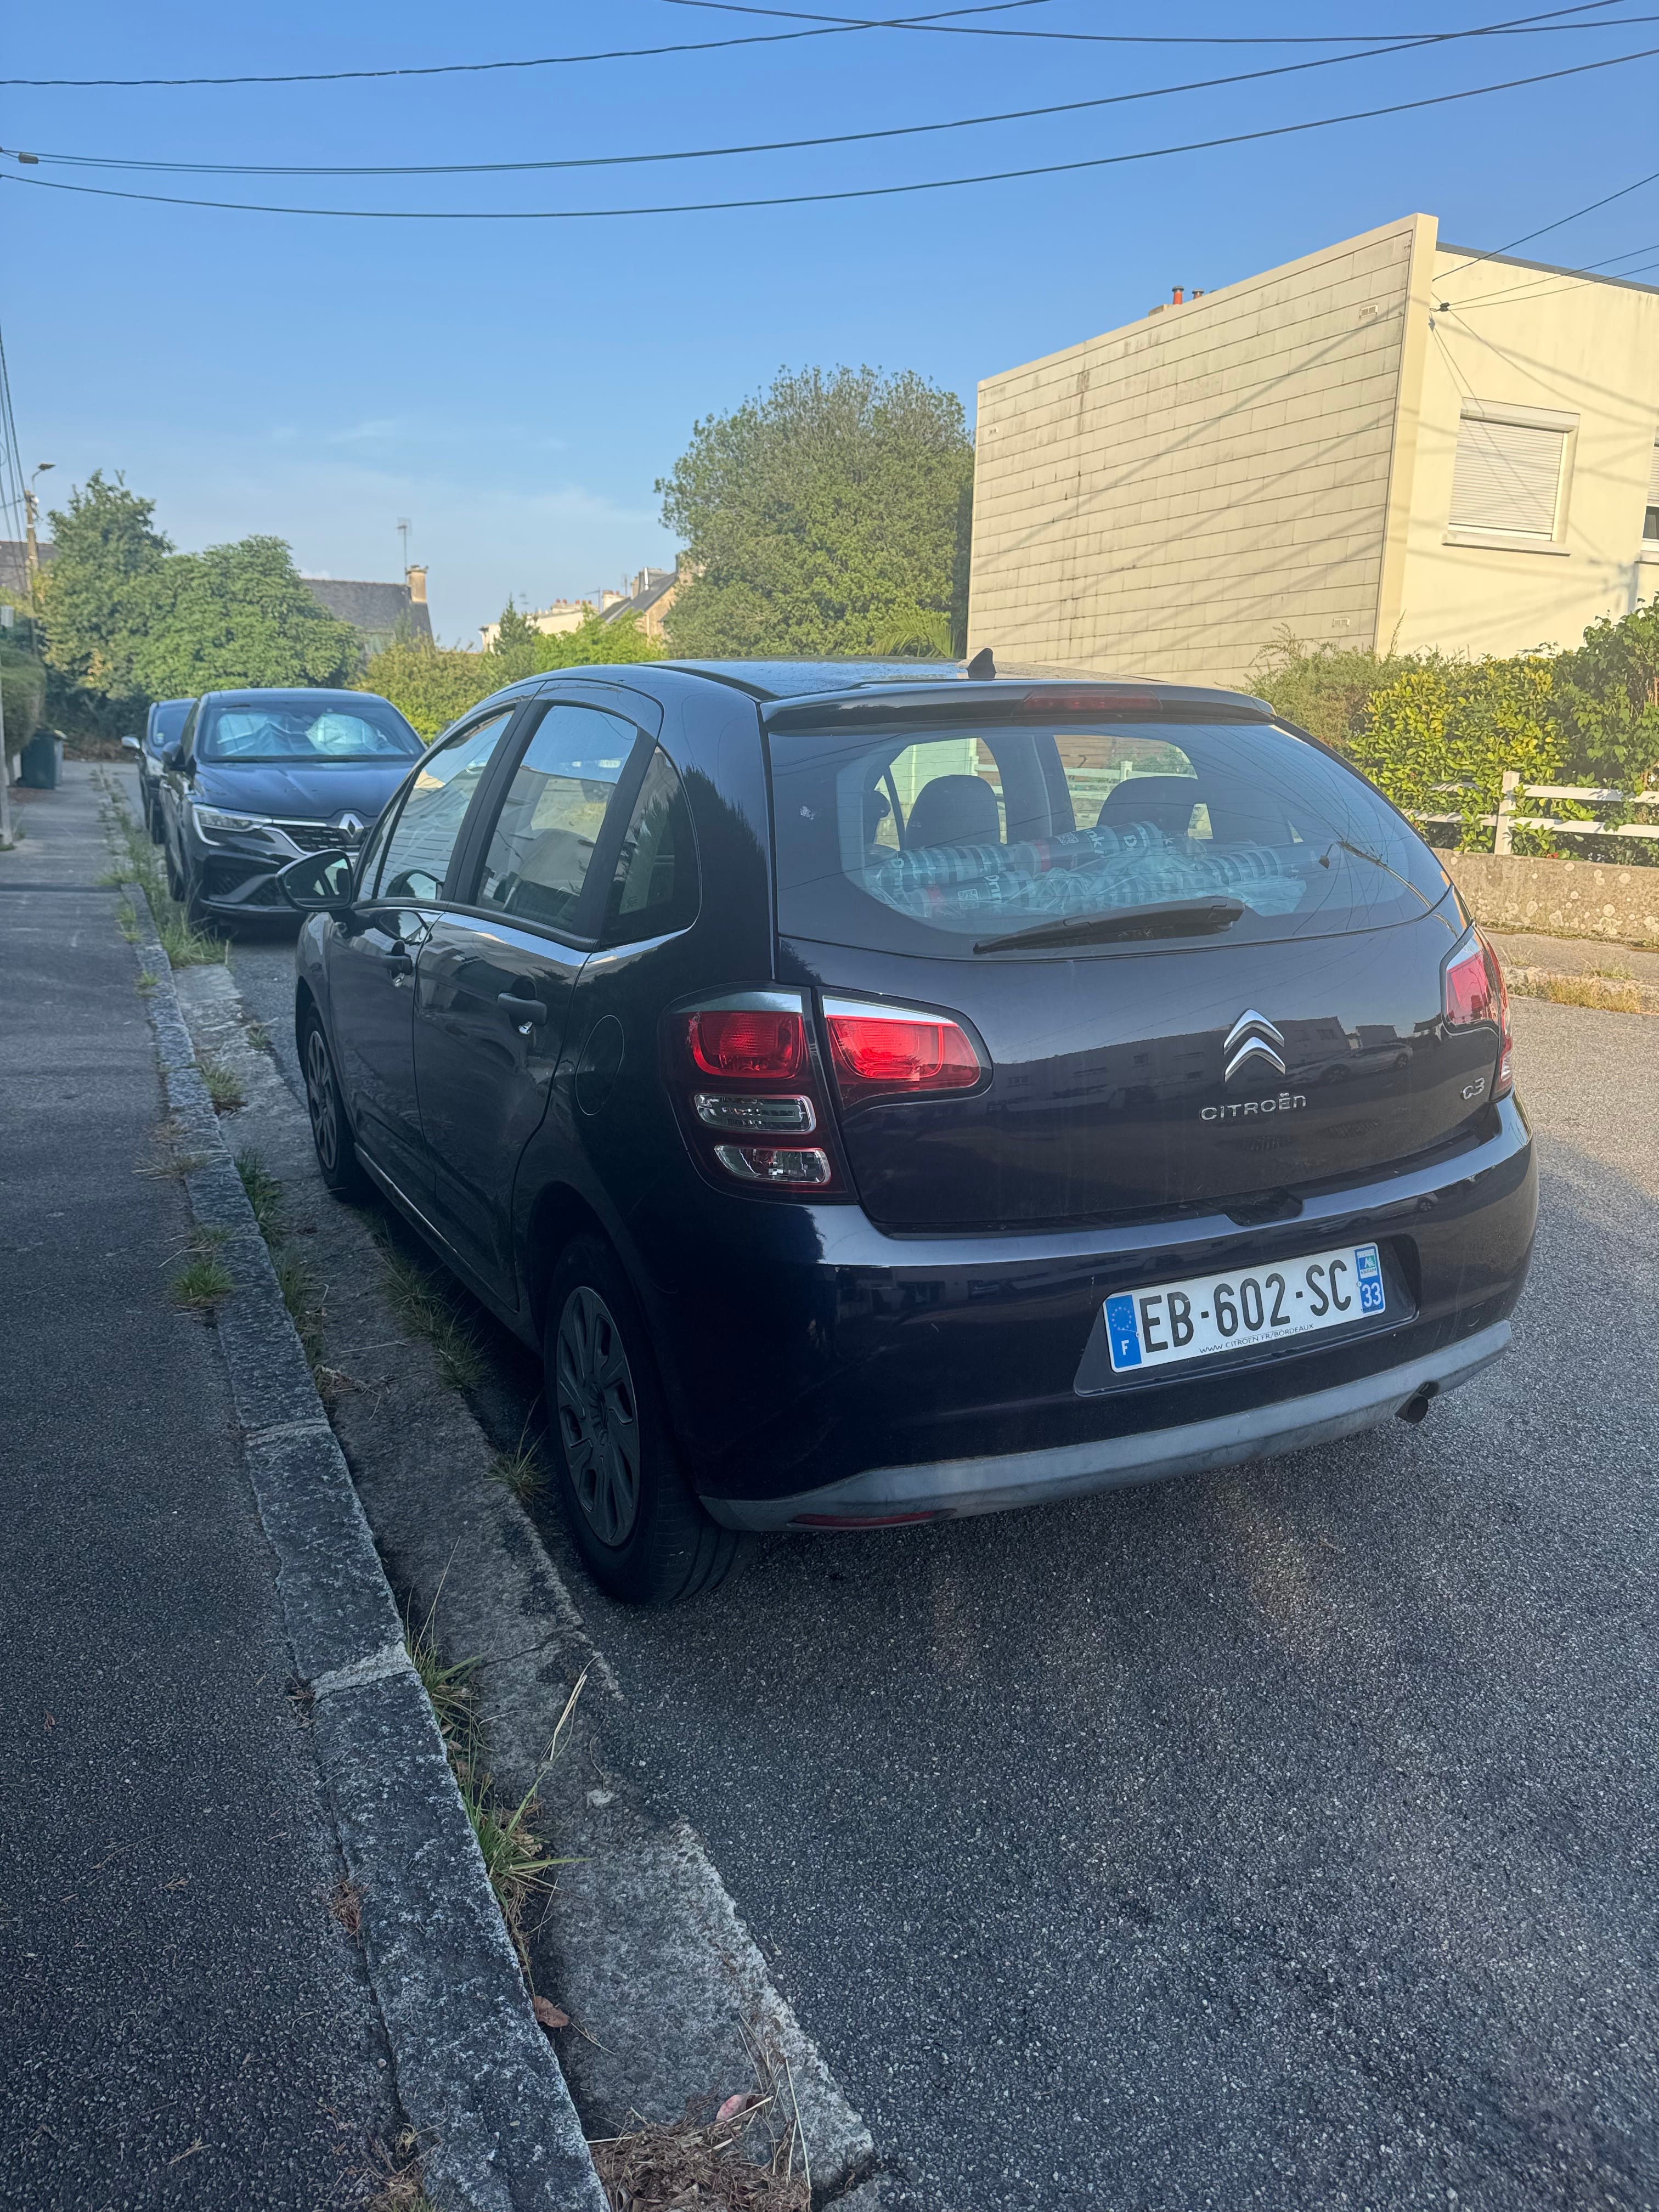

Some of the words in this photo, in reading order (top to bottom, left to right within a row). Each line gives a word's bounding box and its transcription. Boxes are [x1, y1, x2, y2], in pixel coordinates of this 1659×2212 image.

[1462, 1077, 1485, 1100] C3
[1139, 1260, 1351, 1353] EB-602-SC
[1362, 1282, 1381, 1307] 33
[1121, 1339, 1130, 1356] F
